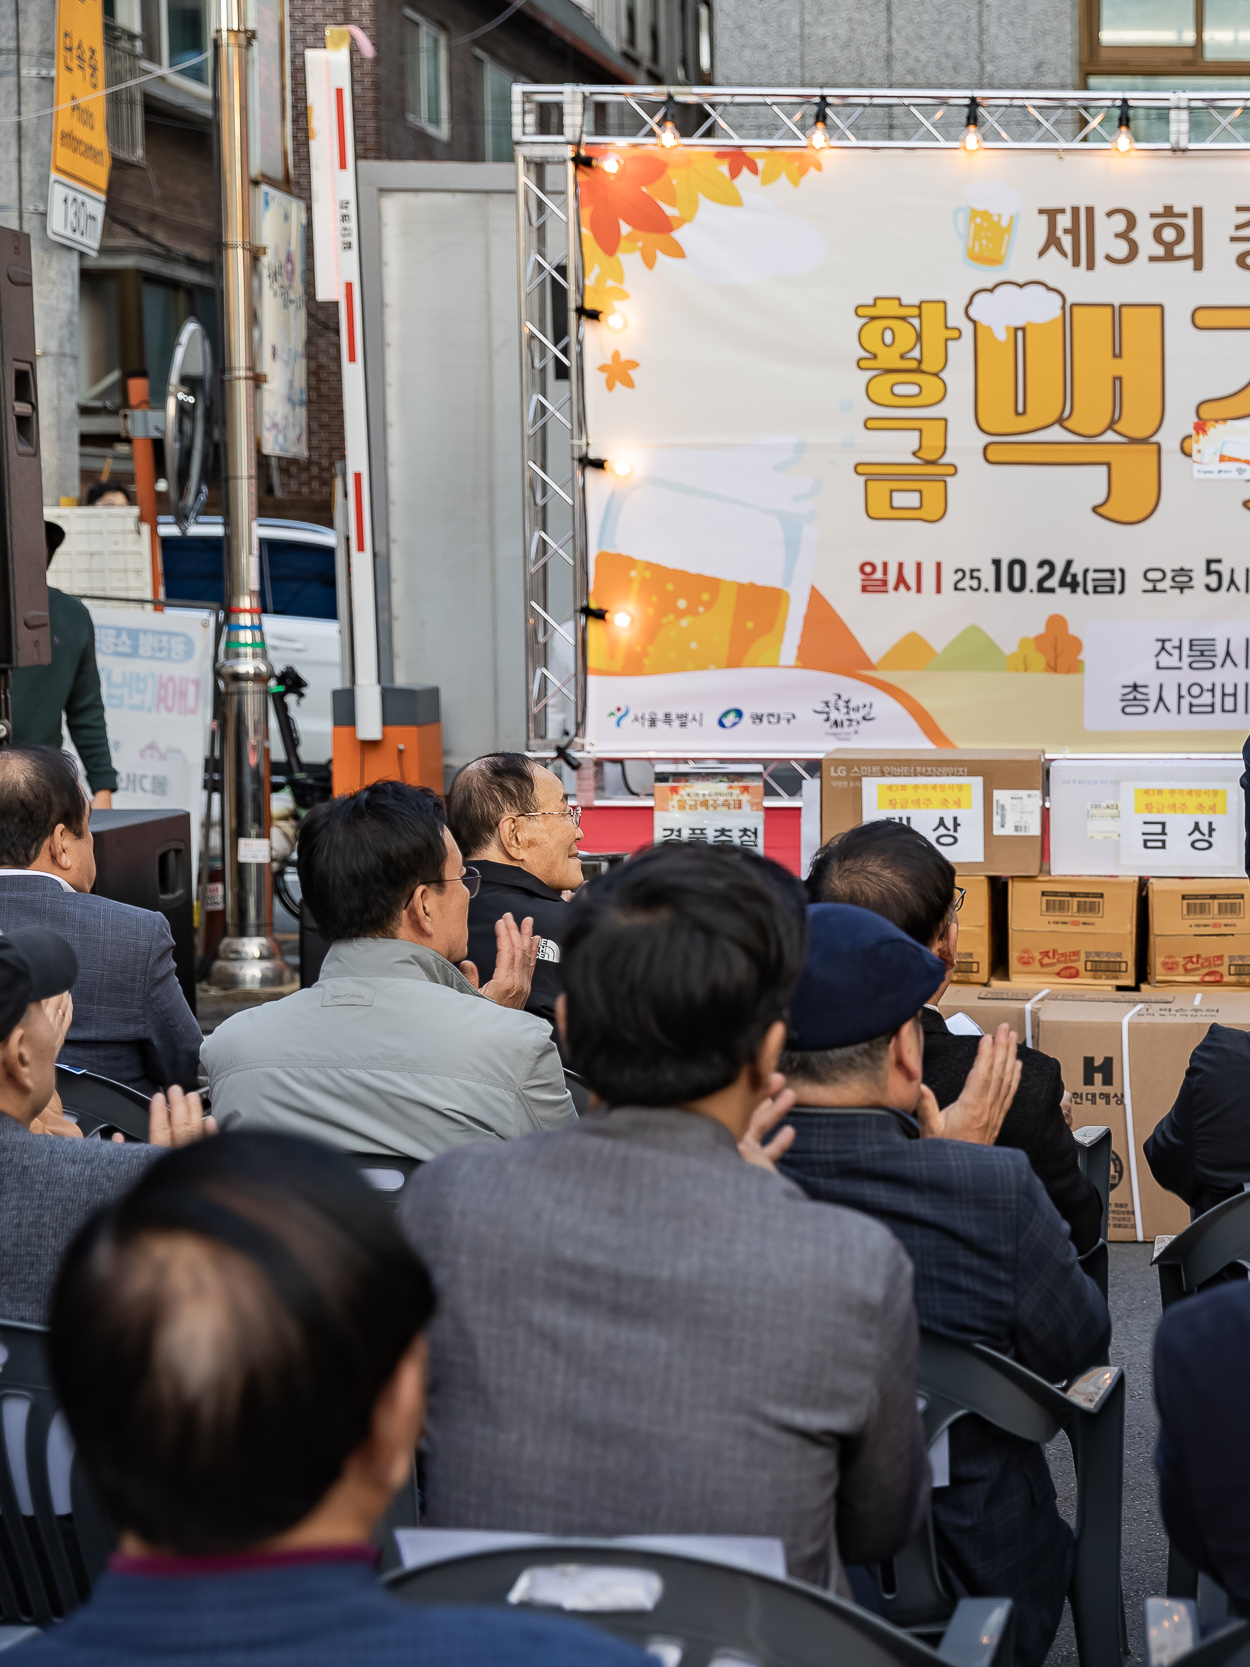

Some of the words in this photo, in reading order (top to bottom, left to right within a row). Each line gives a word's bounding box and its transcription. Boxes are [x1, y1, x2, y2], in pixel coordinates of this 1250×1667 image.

[63, 29, 99, 90] 단속중
[70, 93, 95, 131] Photo
[62, 194, 99, 244] 130m
[1038, 203, 1204, 272] 제3회
[854, 297, 962, 523] 황금
[859, 561, 923, 594] 일시
[953, 557, 1126, 596] 25.10.24(금)
[1141, 566, 1195, 594] 오후
[1204, 558, 1250, 594] 5시
[1119, 681, 1249, 716] 총사업비
[631, 710, 703, 729] 서울특별시
[750, 711, 797, 726] 광진구
[830, 766, 847, 777] LG
[850, 766, 881, 777] 스마트
[1071, 1091, 1125, 1106] 현대해상
